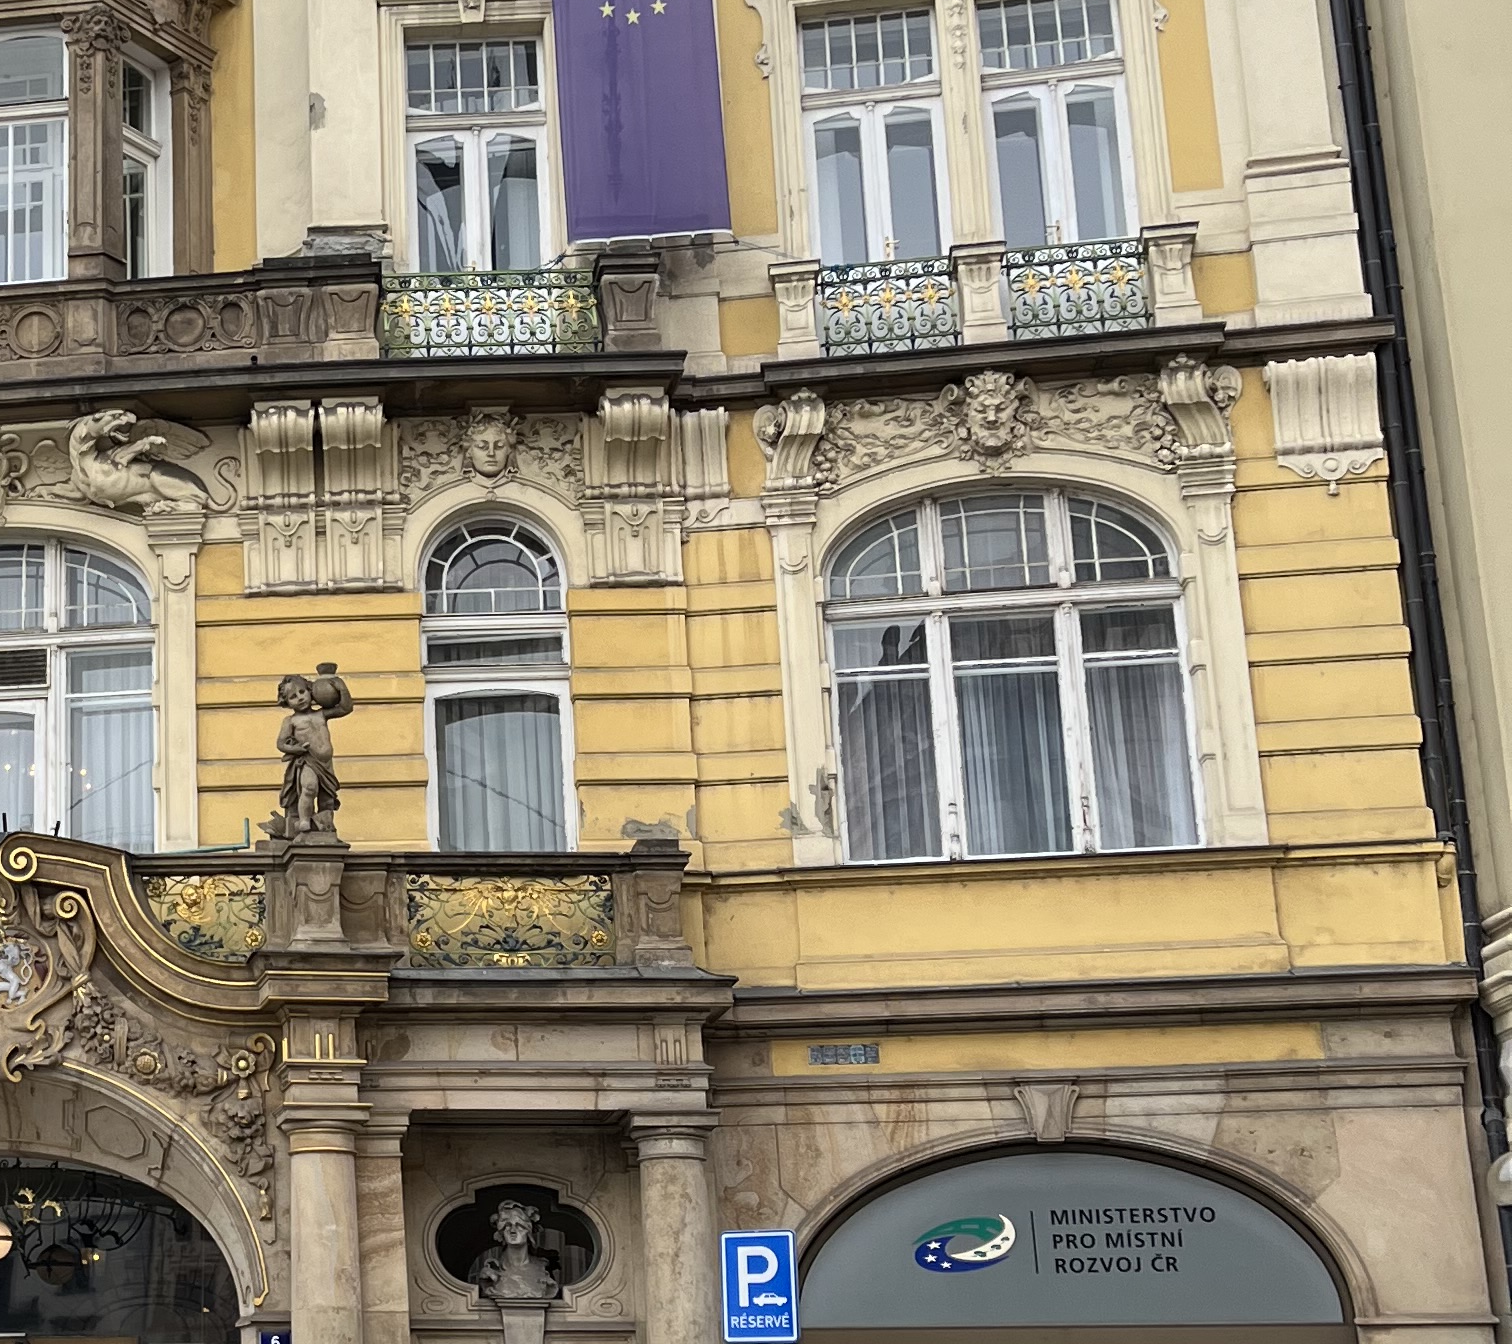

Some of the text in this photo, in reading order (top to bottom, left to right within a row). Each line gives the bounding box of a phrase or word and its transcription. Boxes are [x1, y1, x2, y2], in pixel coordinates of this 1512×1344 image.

[1050, 1207, 1216, 1225] MINISTERSTVO
[1052, 1229, 1183, 1249] PRO MÍSTNÍ
[1055, 1254, 1179, 1274] ROZVOJ ČR
[737, 1246, 778, 1307] P
[731, 1312, 790, 1328] RÉSERVÉ
